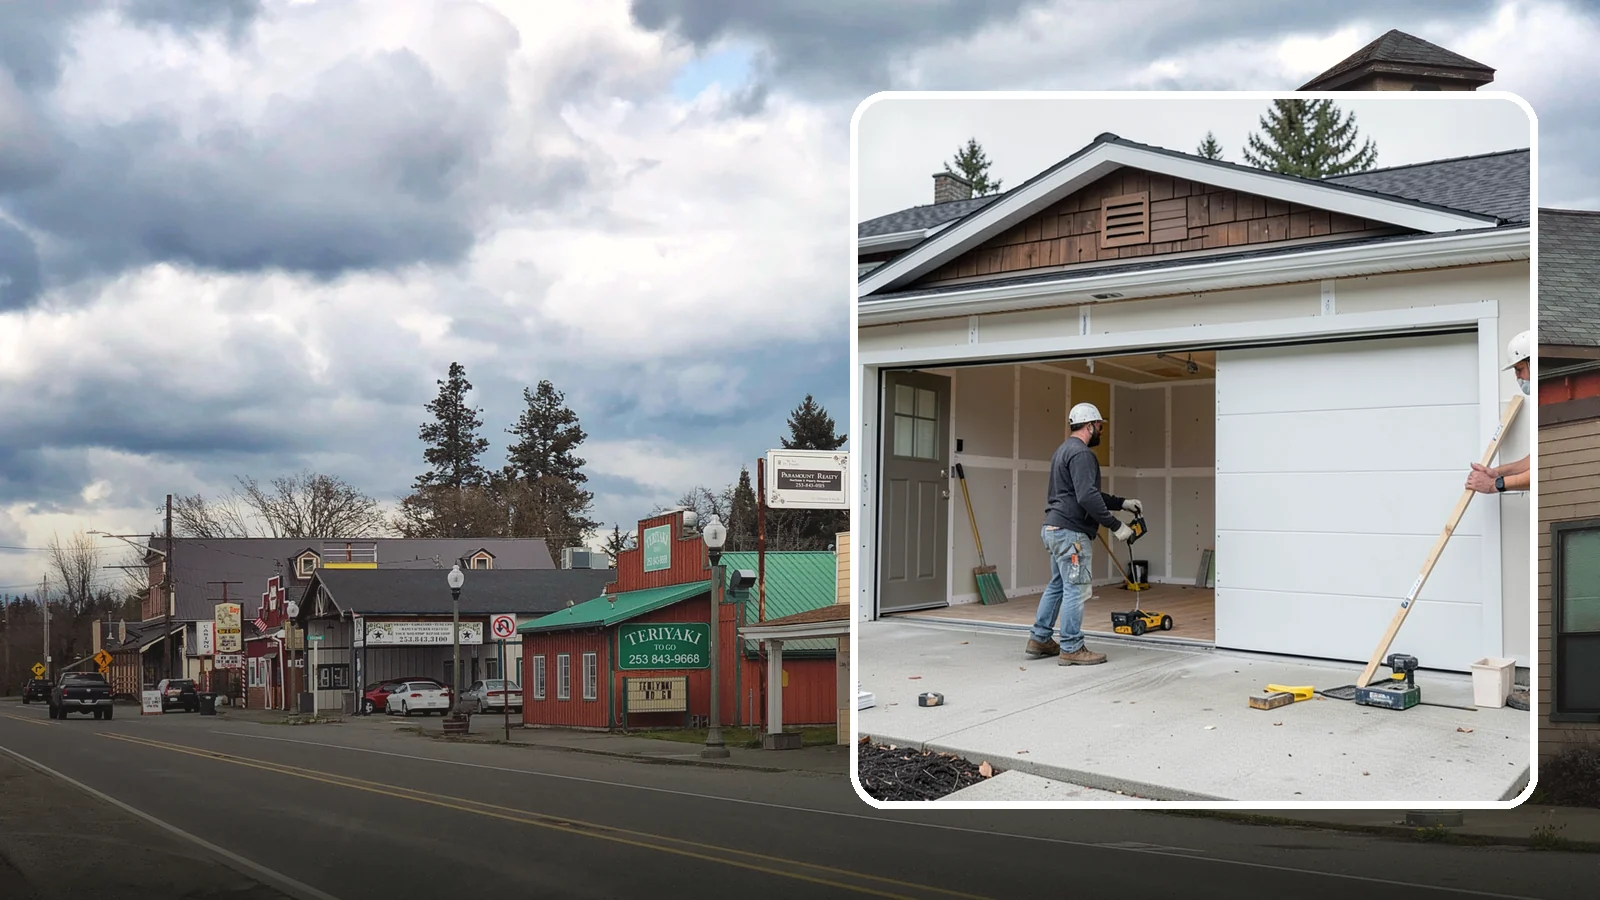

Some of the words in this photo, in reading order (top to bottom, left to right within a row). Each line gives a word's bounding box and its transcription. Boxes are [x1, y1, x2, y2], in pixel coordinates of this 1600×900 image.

[781, 471, 815, 479] PARAMOUNT
[817, 472, 839, 480] REALTY
[399, 635, 448, 643] 253.843.3100
[624, 627, 702, 646] TERIYAKI
[628, 654, 649, 665] 253
[651, 653, 700, 665] 843-9668
